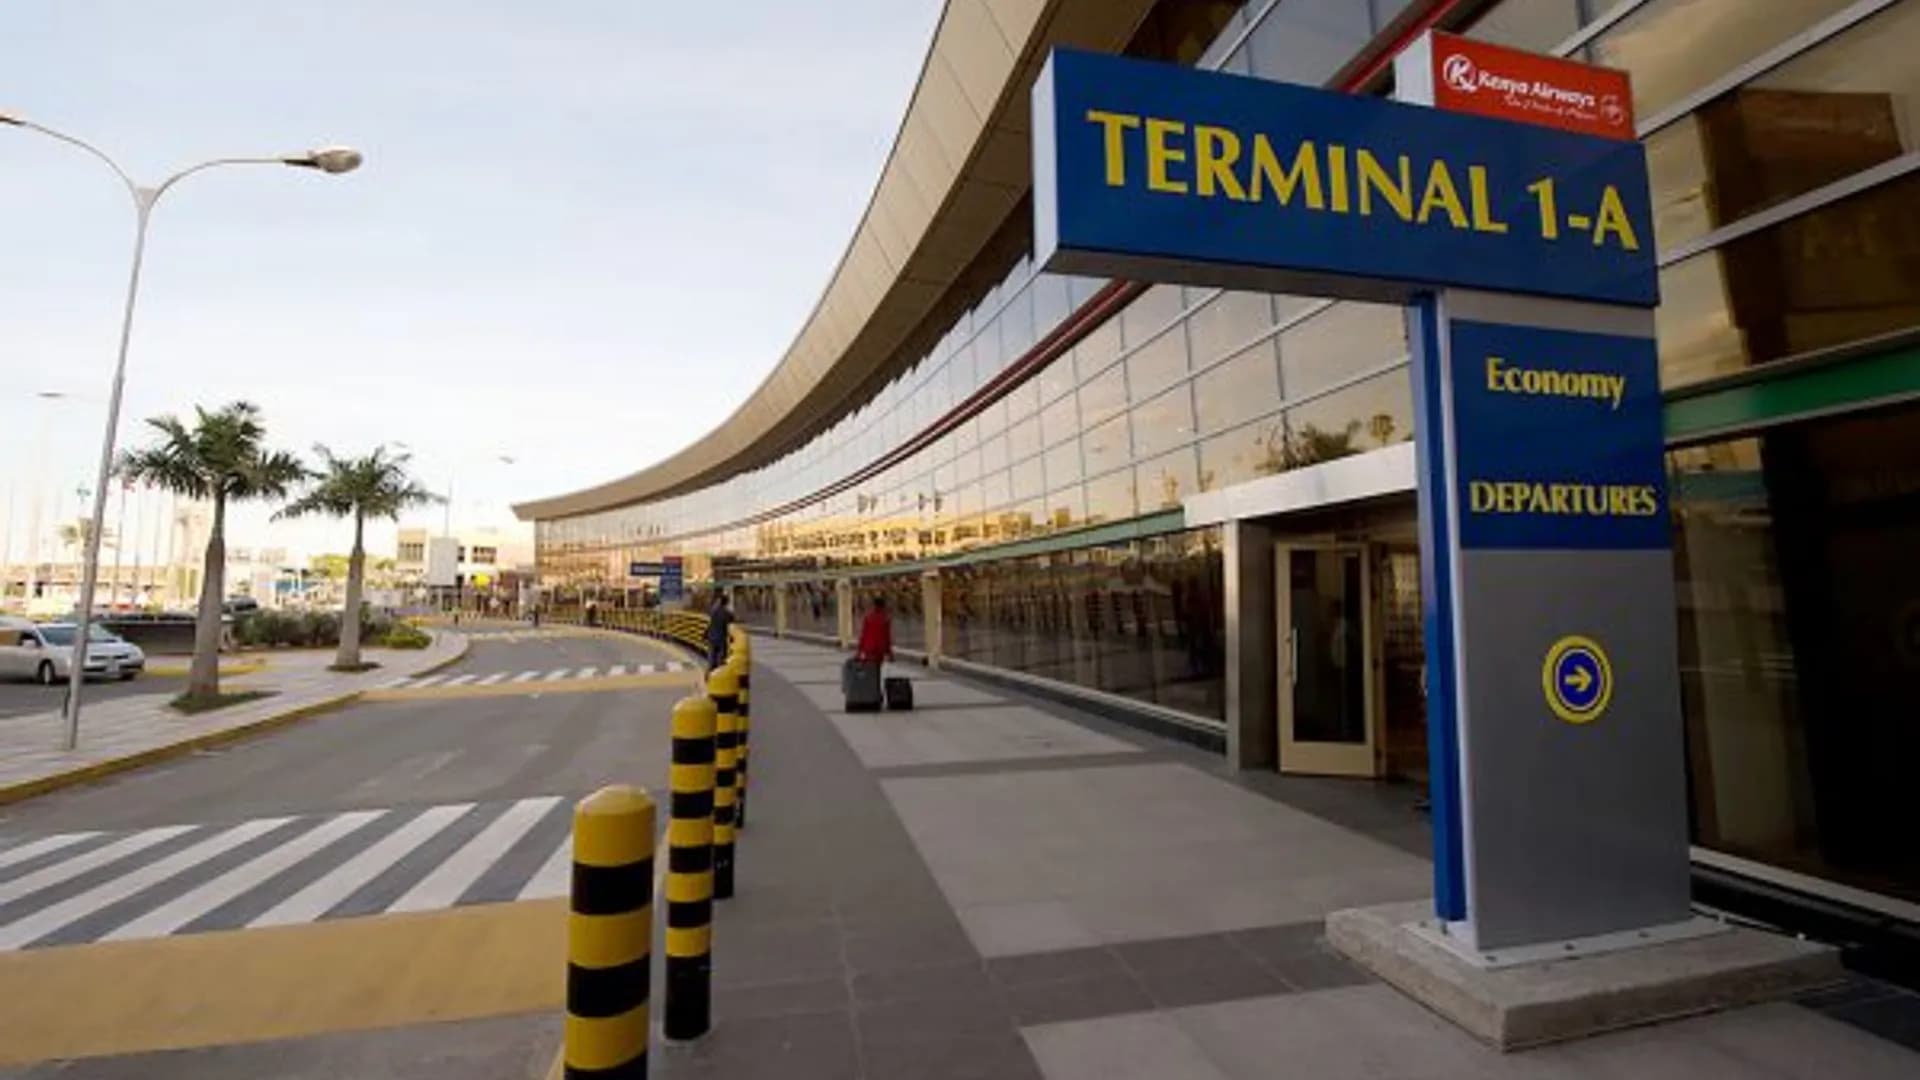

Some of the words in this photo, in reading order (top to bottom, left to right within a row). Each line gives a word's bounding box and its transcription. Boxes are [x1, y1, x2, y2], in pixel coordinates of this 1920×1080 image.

[1478, 70, 1529, 95] Kenya
[1530, 80, 1596, 110] Airways
[1086, 109, 1508, 234] TERMINAL
[1527, 176, 1640, 251] 1-A
[1485, 356, 1626, 410] Economy
[1468, 480, 1657, 516] DEPARTURES
